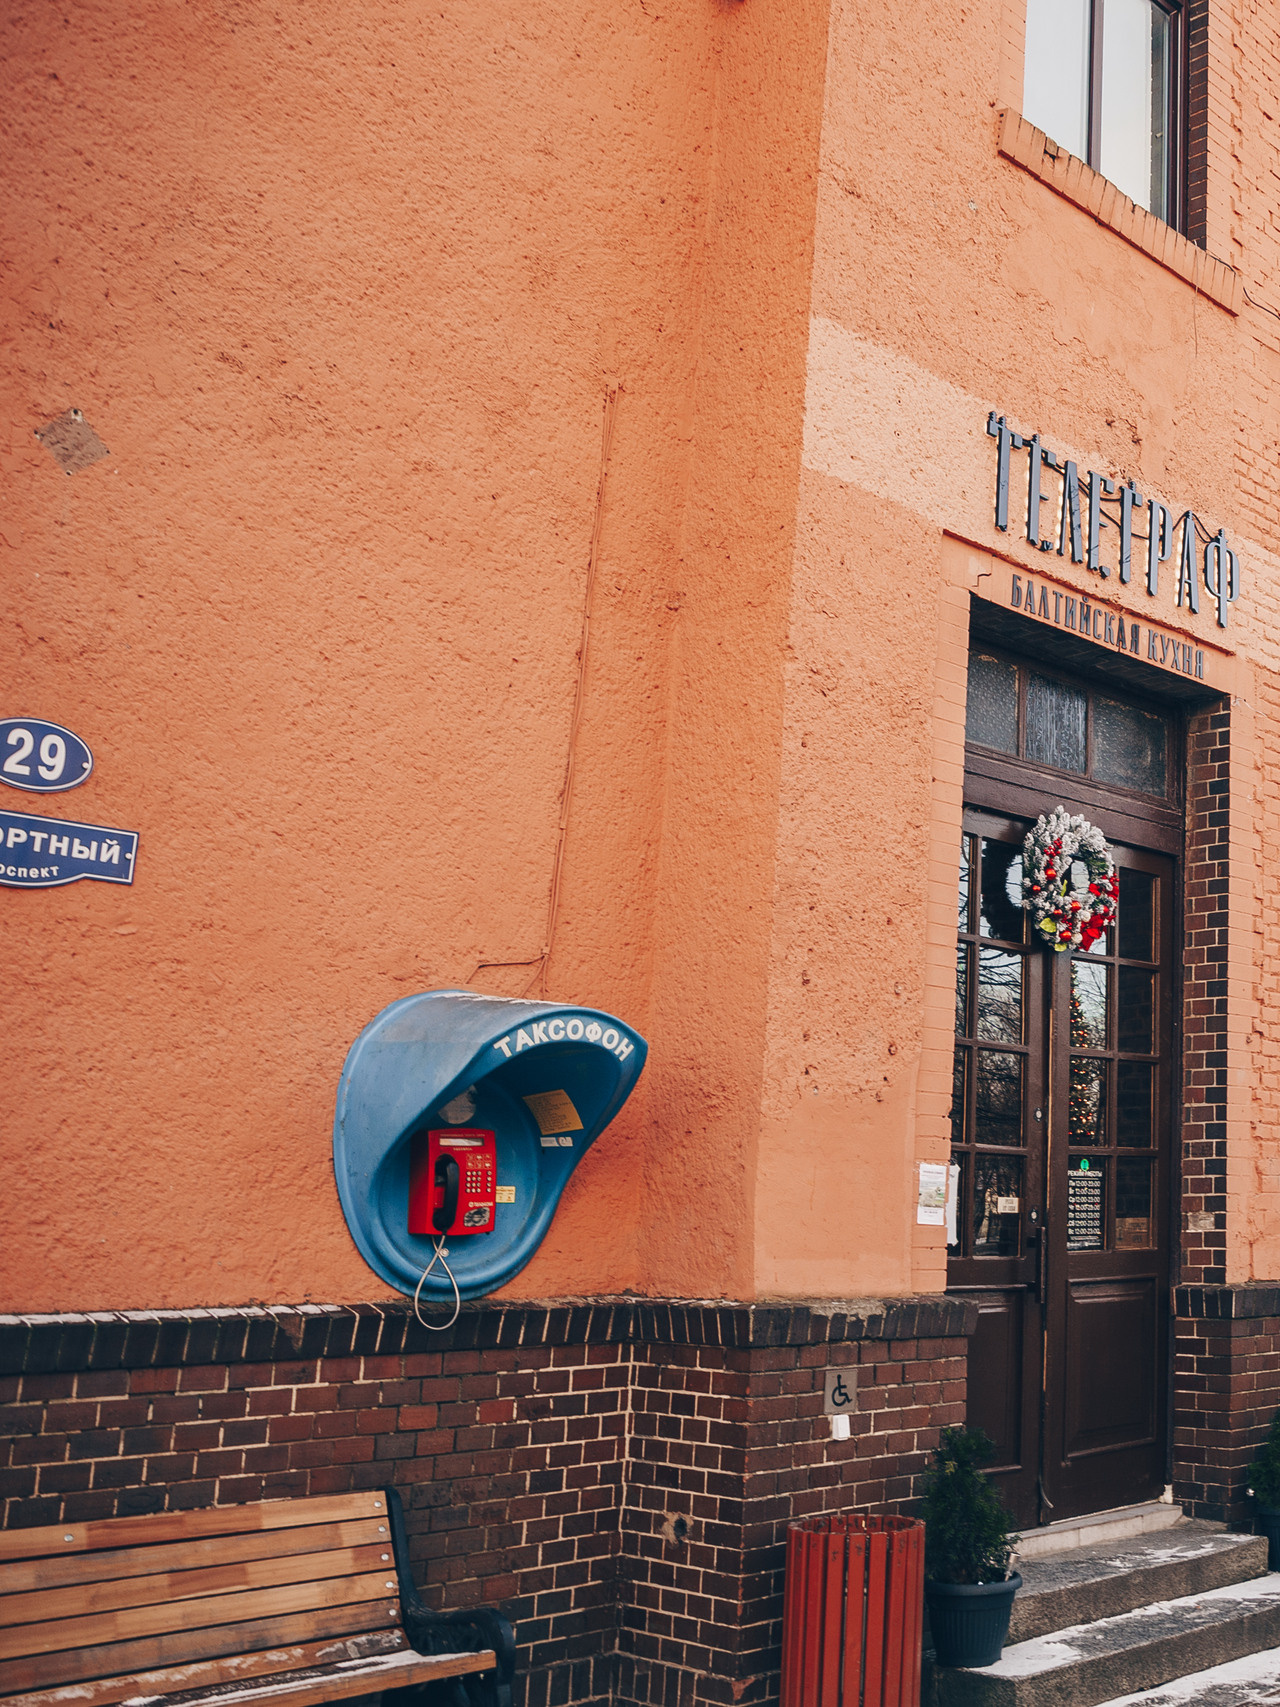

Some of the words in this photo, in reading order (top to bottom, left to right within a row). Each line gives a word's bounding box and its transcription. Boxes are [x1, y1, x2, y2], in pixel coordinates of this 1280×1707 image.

[986, 411, 1240, 628] ТЕЛЕГРАФ
[1011, 574, 1141, 655] БАЛТИЙСКАЯ
[1148, 629, 1205, 679] КУХНЯ
[3, 728, 67, 781] 29
[0, 826, 121, 865] РТНЫЙ
[493, 1018, 635, 1062] ТАКСОФОН
